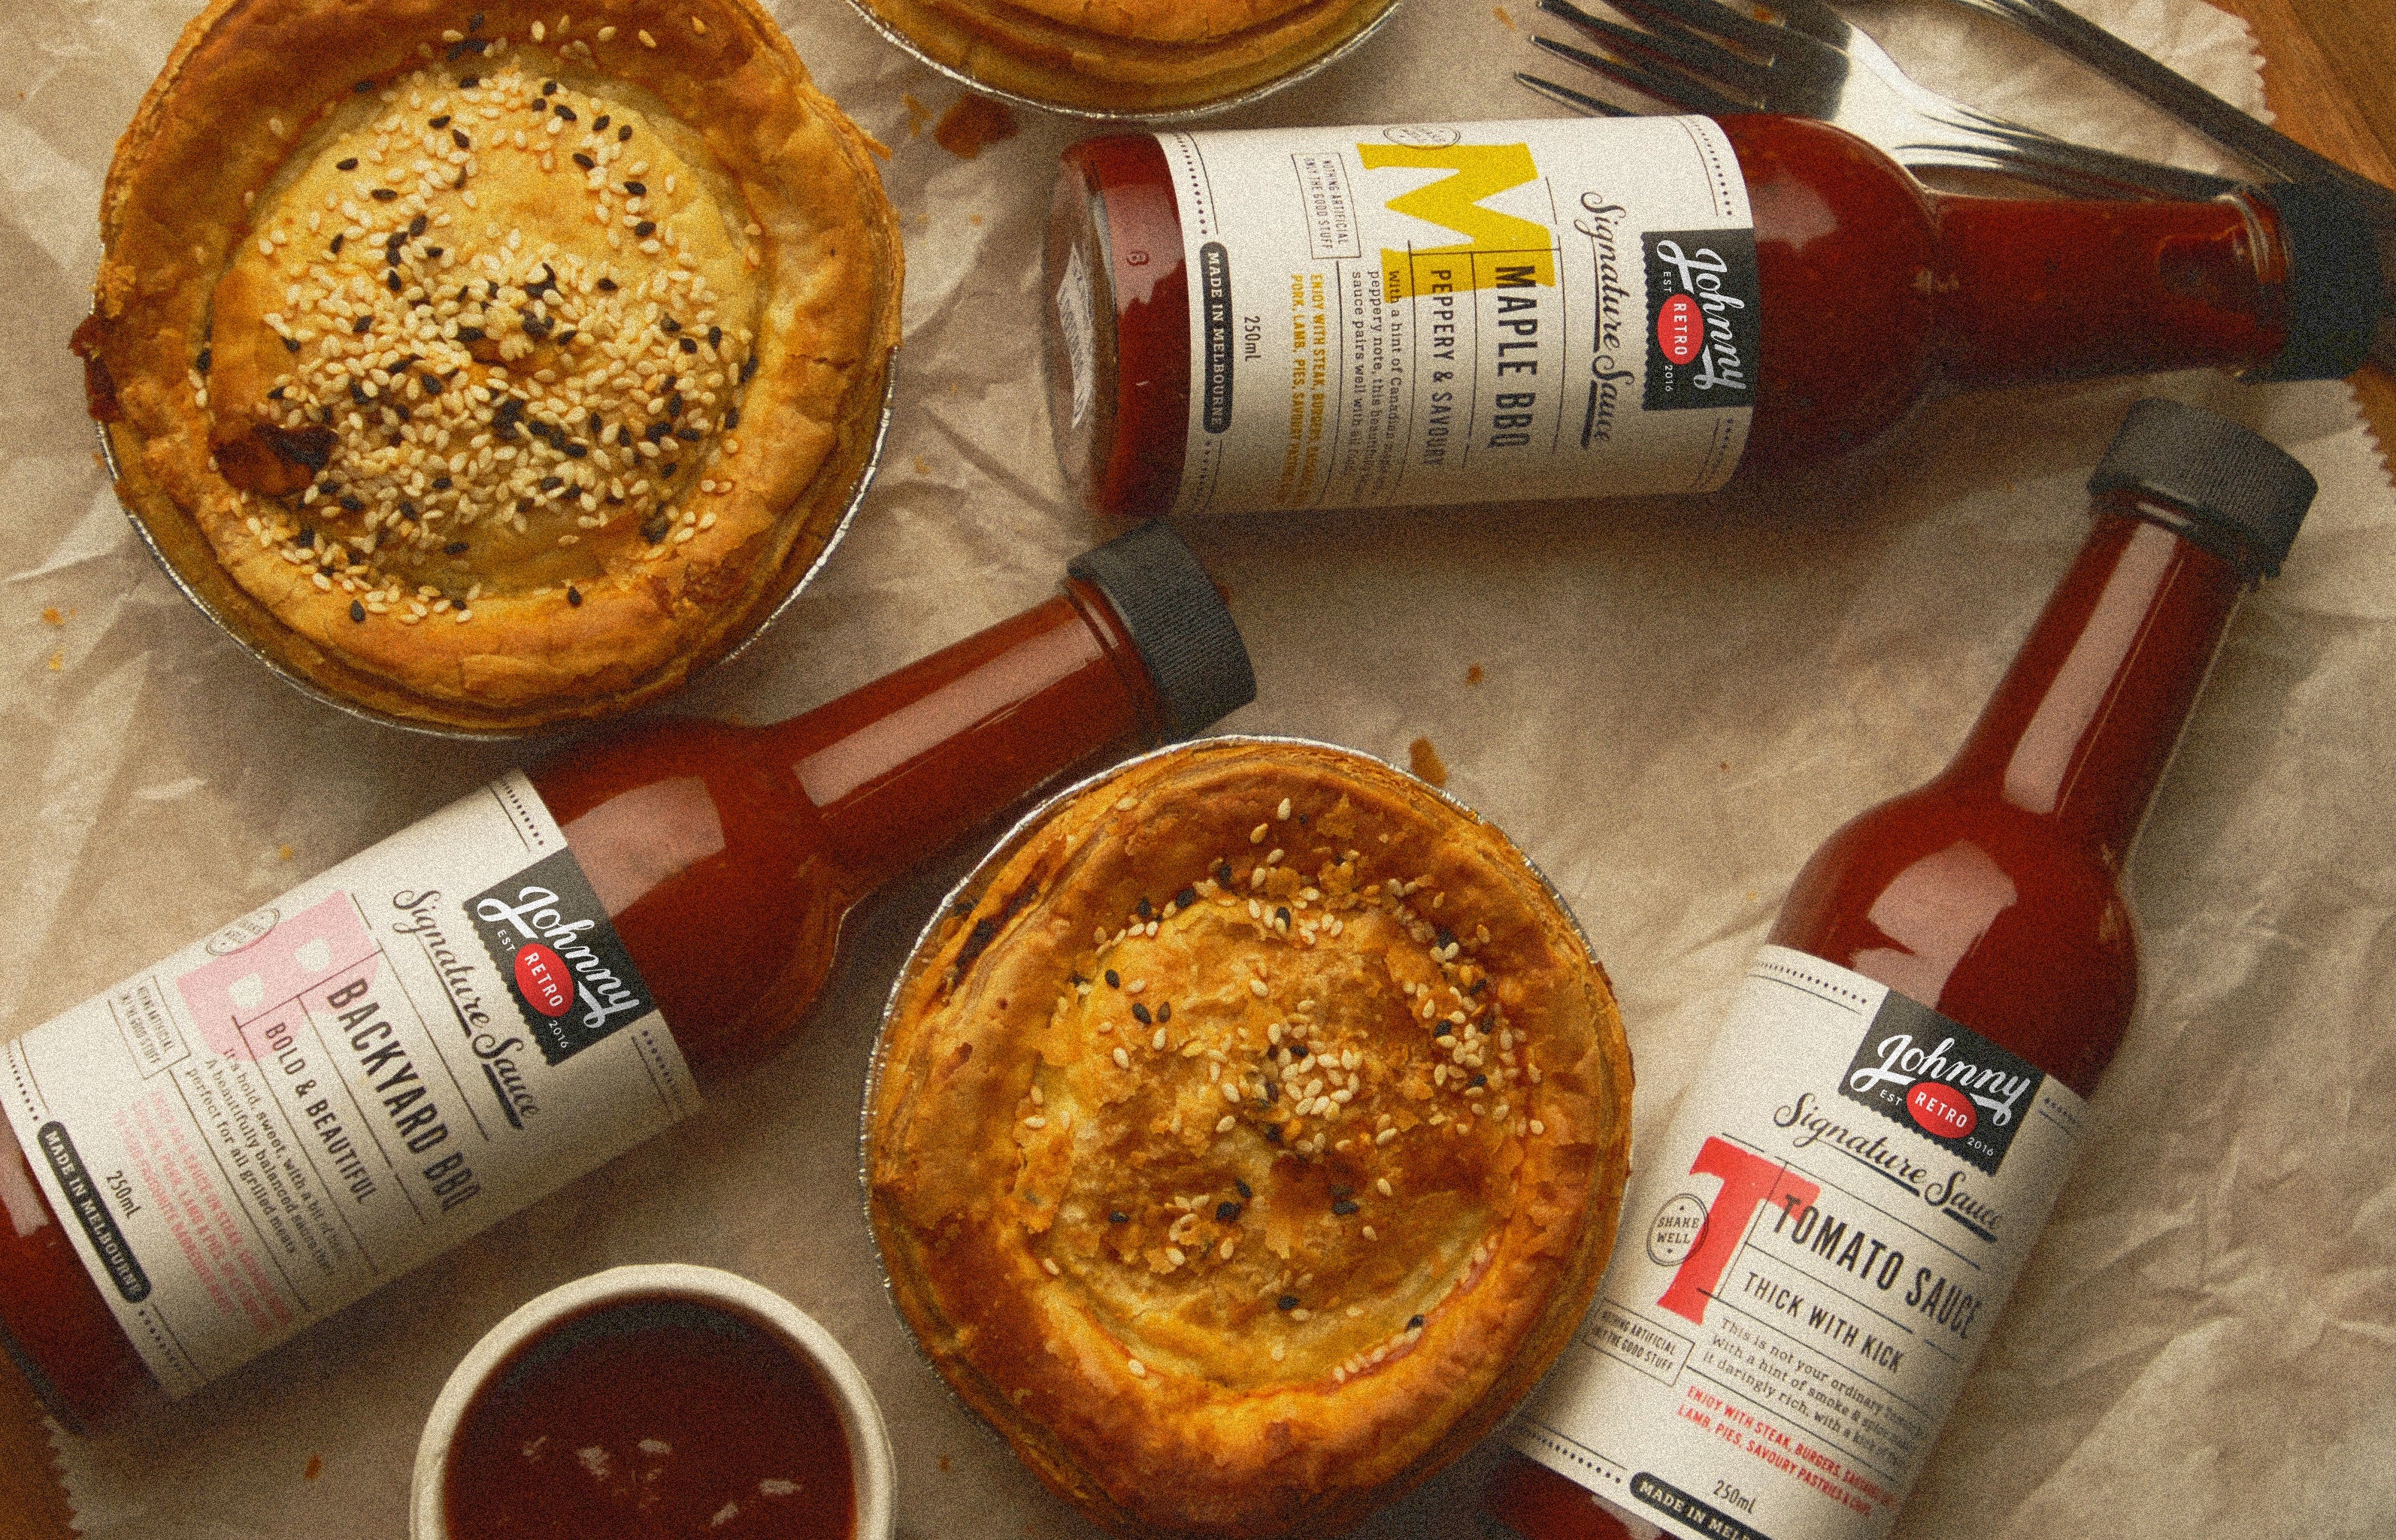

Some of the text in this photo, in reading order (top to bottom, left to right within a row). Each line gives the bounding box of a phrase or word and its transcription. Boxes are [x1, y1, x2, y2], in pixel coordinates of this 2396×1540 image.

[1316, 219, 1332, 249] STUFF
[1329, 195, 1348, 244] ARTIFICIAL
[1356, 143, 1555, 304] M
[1290, 274, 1304, 311] PORK,
[1310, 274, 1323, 309] ENJOY
[1352, 271, 1362, 315] sauce
[1368, 271, 1383, 331] peppery
[1388, 270, 1401, 303] With
[1207, 252, 1223, 425] MADE IN MELBOURNE
[1243, 316, 1260, 361] 250mL
[1292, 315, 1305, 352] LAMB,
[1311, 314, 1325, 344] WITH
[1351, 320, 1365, 359] pairs
[1390, 323, 1401, 352] hint
[1573, 191, 1634, 447] Signature Sauce
[1657, 240, 1746, 389] Johnny
[1663, 271, 1687, 392] EST RETRO 2016
[1310, 349, 1325, 389] STEAK,
[1353, 365, 1365, 394] well
[1371, 337, 1383, 374] note,
[1390, 358, 1402, 373] of
[1422, 269, 1454, 465] PEPPERY & SAVOURY
[1487, 265, 1537, 448] MAPLE BBQ
[1351, 398, 1364, 426] with
[1371, 378, 1383, 405] this
[477, 889, 639, 1026] Johnny
[393, 893, 541, 1129] Signature Sauce
[495, 928, 569, 1049] EST RETRO 2016
[264, 1021, 307, 1078] BOLD
[184, 1066, 223, 1121] perfect
[294, 1077, 319, 1097] &
[326, 977, 483, 1212] BACKYARD BBQ
[1850, 1037, 2031, 1125] Johnny
[208, 1070, 263, 1151] beautifully
[253, 1148, 299, 1214] balanced
[215, 1120, 238, 1146] for
[1879, 1088, 1995, 1157] EST RETRO 2016
[229, 1145, 250, 1168] all
[255, 1110, 289, 1159] sweet,
[280, 1157, 307, 1191] with
[300, 1191, 312, 1202] a
[304, 1098, 379, 1205] BEAUTIFUL
[1774, 1093, 2004, 1244] Signature Sauce
[44, 1130, 143, 1296] MADE IN MELBOURNE
[105, 1169, 144, 1219] 250mL
[238, 1167, 276, 1216] grilled
[1656, 1218, 1699, 1230] SHAKE
[1656, 1232, 1690, 1245] WELL
[1768, 1194, 1985, 1341] TOMATO SAUCE
[1628, 1324, 1677, 1355] ARTIFICIAL
[1740, 1271, 1906, 1375] THICK WITH KICK
[1619, 1338, 1645, 1359] GOOD
[1643, 1350, 1674, 1373] STUFF
[1710, 1334, 1745, 1360] With
[1746, 1355, 1755, 1366] a
[1757, 1359, 1789, 1383] hint
[1789, 1375, 1807, 1392] of
[1806, 1384, 1850, 1416] smoke
[1719, 1318, 1884, 1415] This is not your ordinary
[1686, 1385, 1723, 1412] ENJOY
[1721, 1403, 1755, 1430] WITH
[1752, 1420, 1796, 1453] STEAK,
[1714, 1358, 1777, 1399] daringly
[1777, 1391, 1813, 1418] rich,
[1812, 1409, 1843, 1433] with
[1676, 1403, 1716, 1433] LAMB,
[1713, 1423, 1746, 1449] PIES,
[1744, 1439, 1798, 1476] SAVOURY
[1638, 1481, 1686, 1514] MADE
[1686, 1505, 1706, 1524] IN
